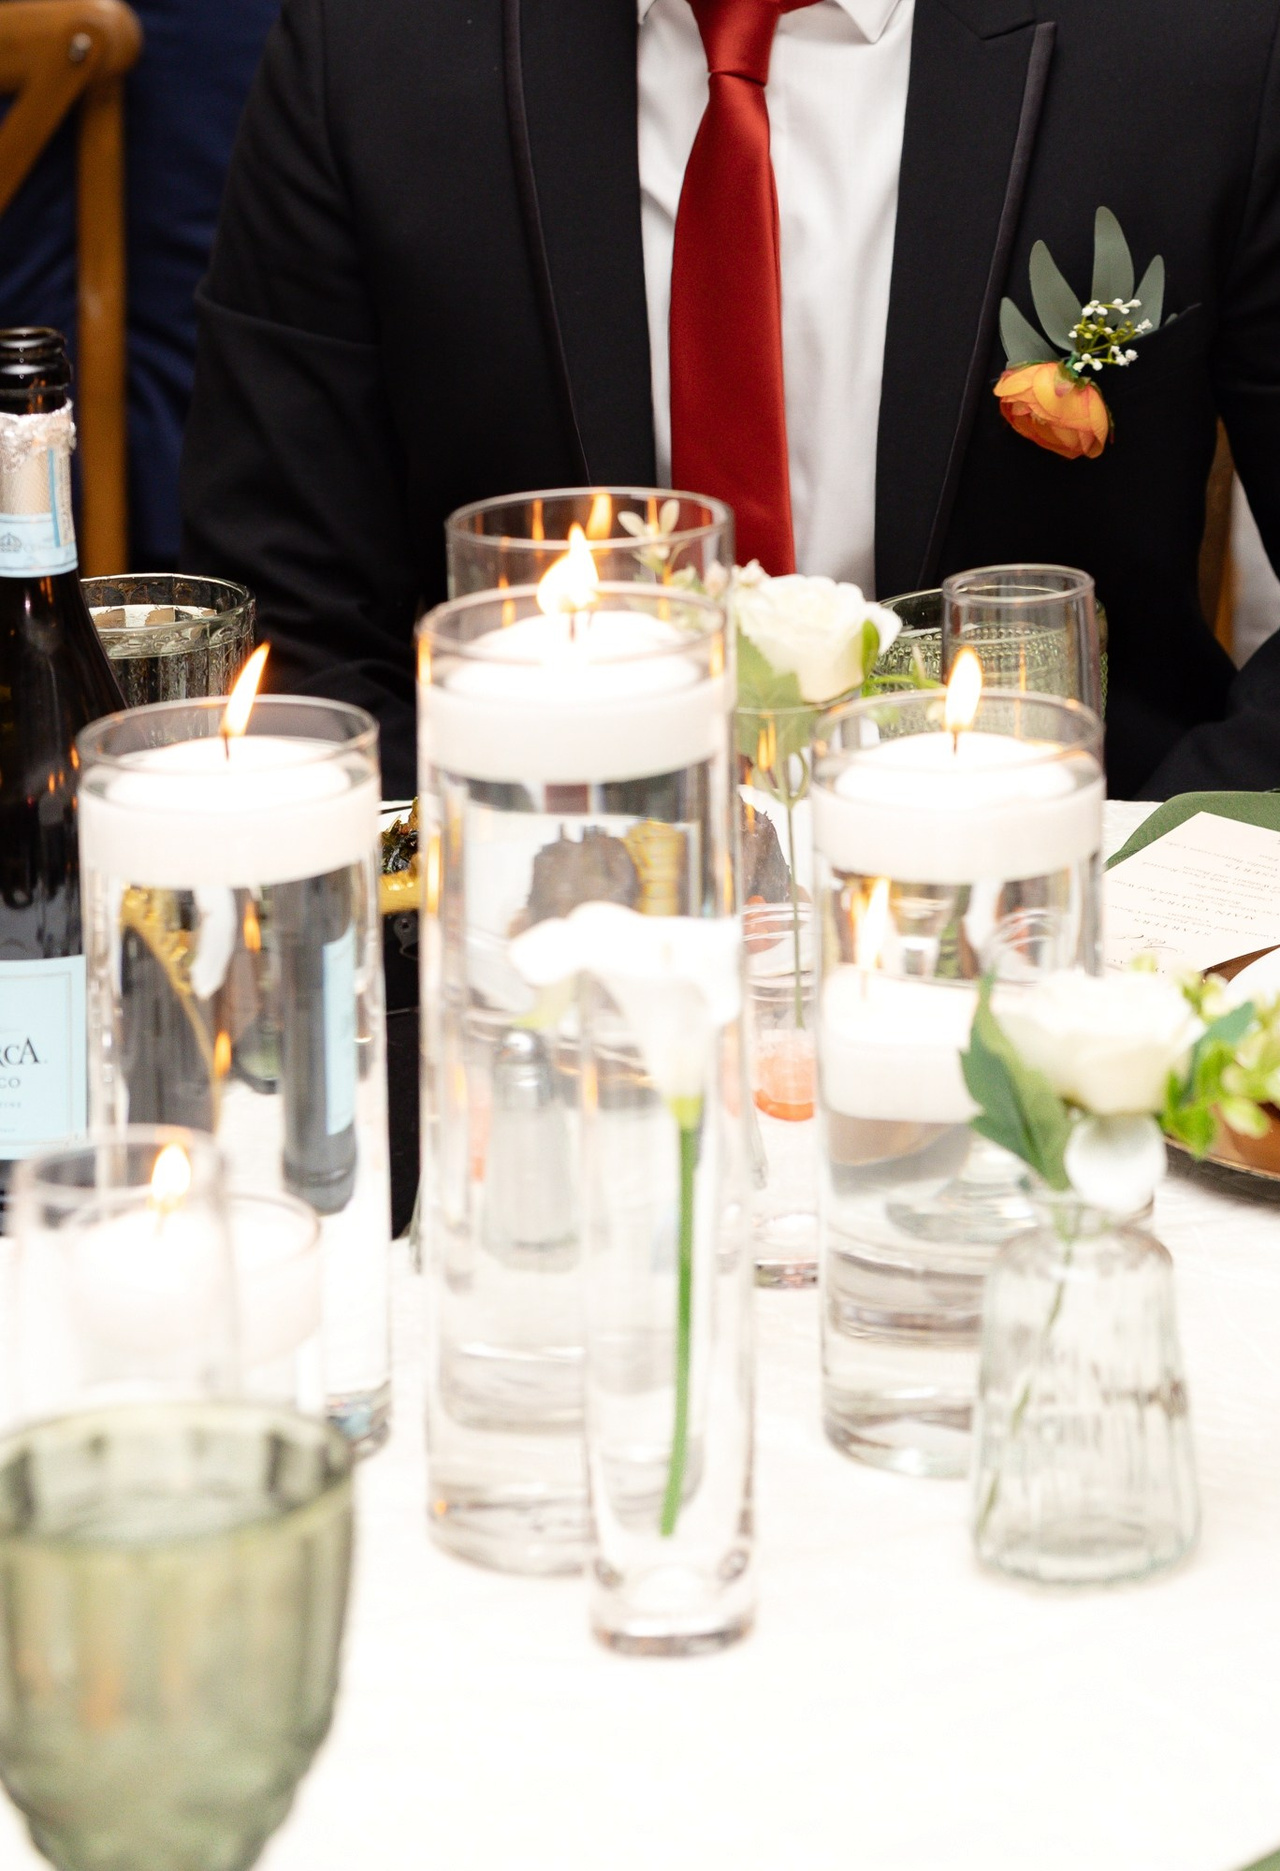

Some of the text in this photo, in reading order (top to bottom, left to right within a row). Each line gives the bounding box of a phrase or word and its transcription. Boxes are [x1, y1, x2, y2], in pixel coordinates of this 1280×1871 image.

[1152, 898, 1209, 910] COURSE
[1214, 910, 1254, 920] MAIN
[1132, 918, 1210, 936] STARTERS
